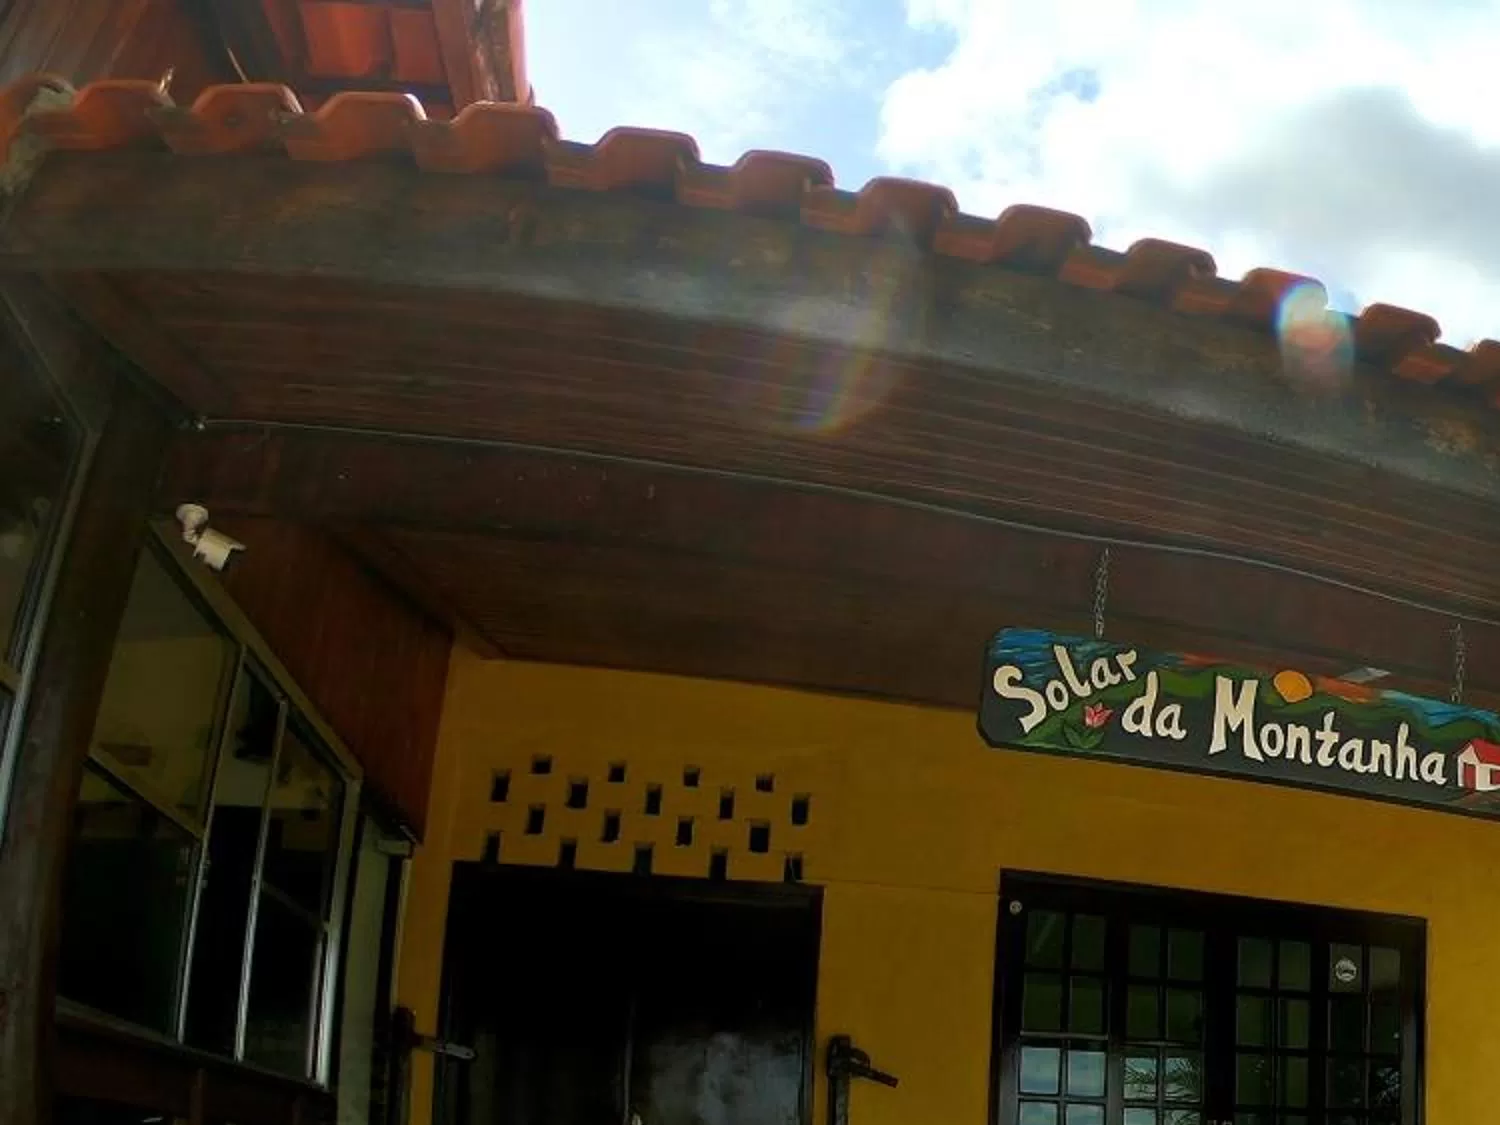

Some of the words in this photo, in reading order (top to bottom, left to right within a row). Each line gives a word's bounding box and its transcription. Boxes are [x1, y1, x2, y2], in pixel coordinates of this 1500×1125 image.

[993, 645, 1138, 733] Solar
[1121, 671, 1187, 740] da
[1209, 676, 1447, 785] Montanha
